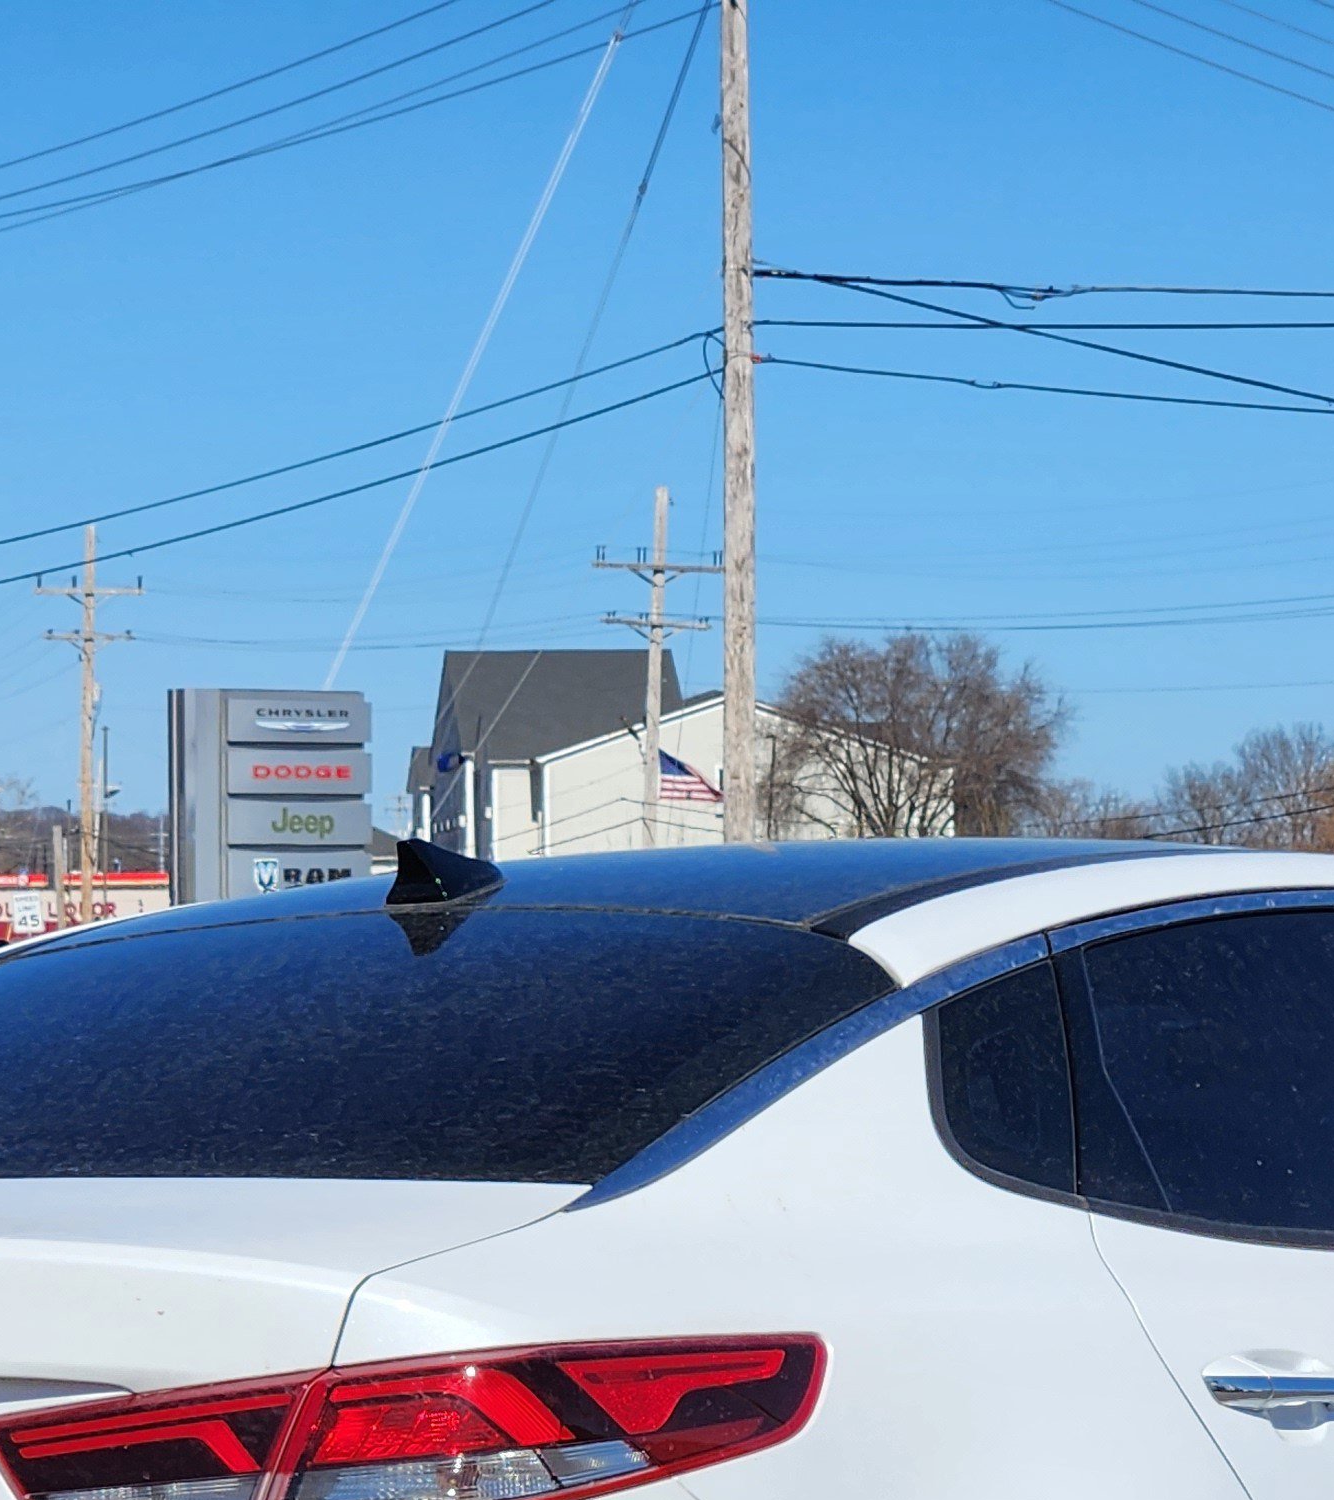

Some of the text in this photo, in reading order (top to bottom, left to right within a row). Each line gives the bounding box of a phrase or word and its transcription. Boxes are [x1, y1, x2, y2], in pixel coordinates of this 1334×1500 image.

[255, 707, 350, 719] CHRYSLER
[251, 764, 352, 781] DODGE
[271, 806, 336, 839] Jeep
[282, 867, 352, 889] RAM
[18, 915, 40, 927] 45
[47, 901, 117, 925] LQOR
